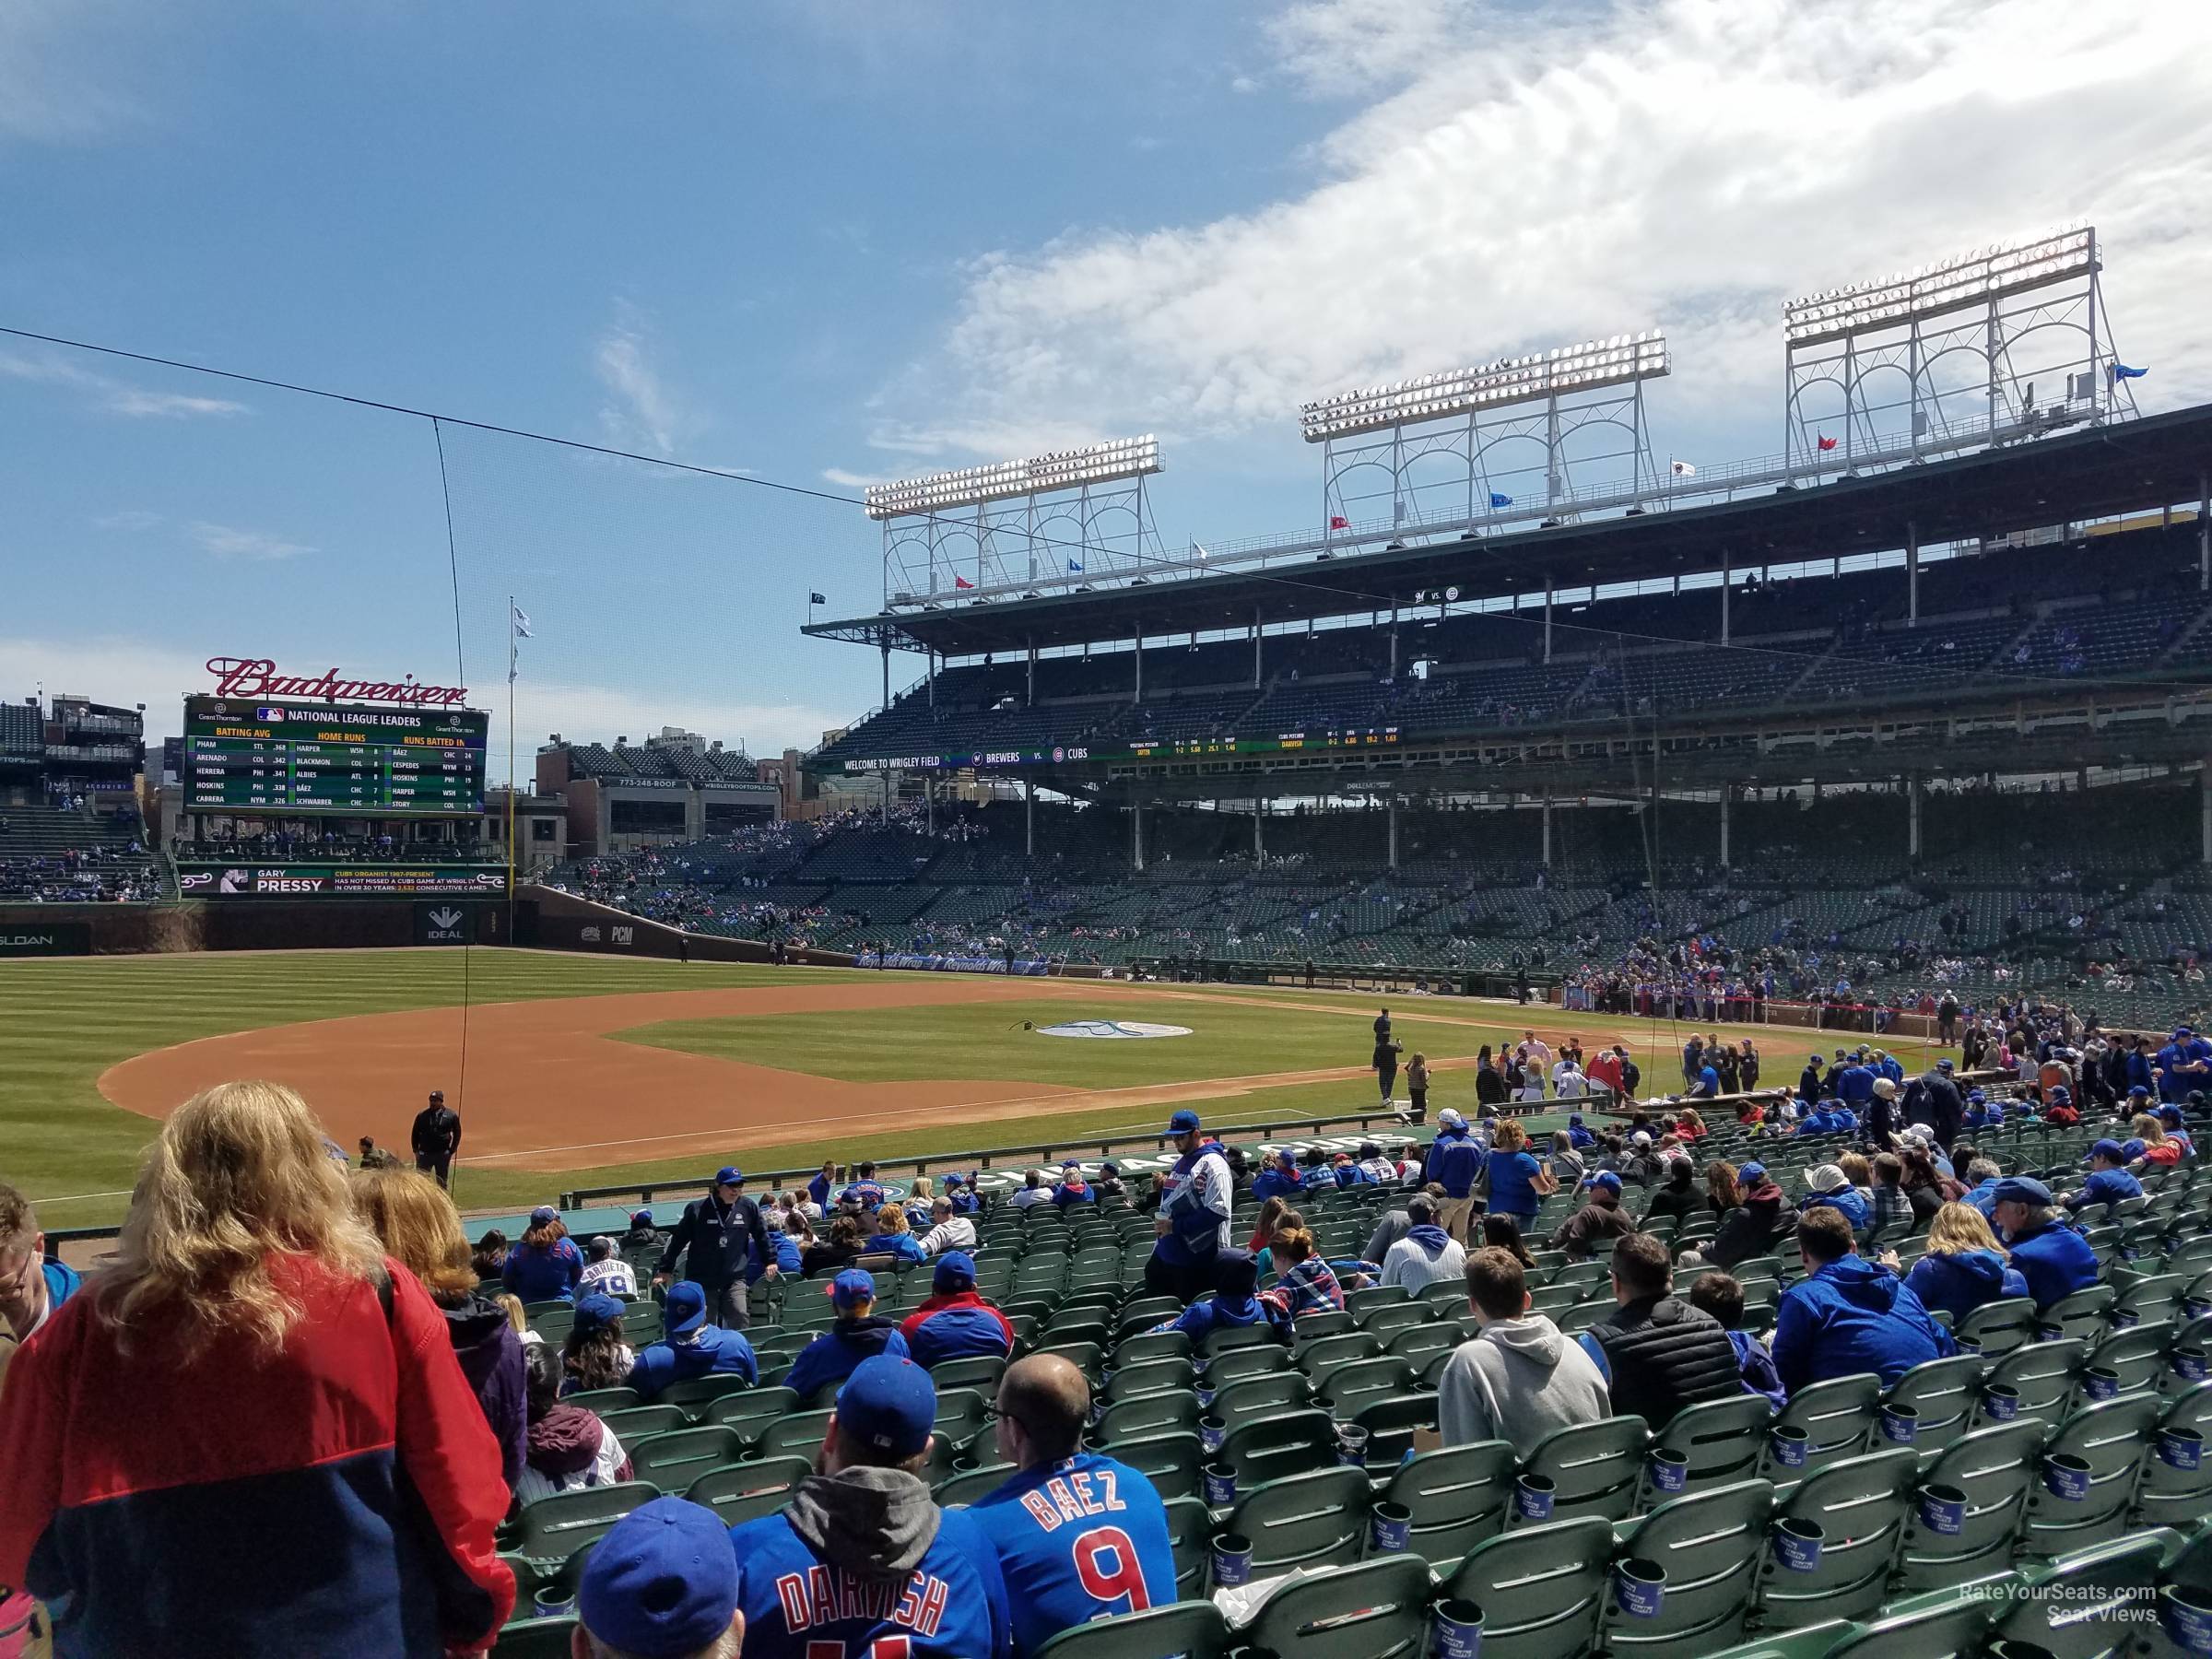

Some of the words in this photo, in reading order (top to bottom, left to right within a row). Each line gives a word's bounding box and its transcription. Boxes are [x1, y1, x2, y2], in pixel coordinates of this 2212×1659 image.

[206, 657, 468, 704] Budweiser
[288, 711, 339, 723] NATIONAL
[343, 713, 378, 724] LEAGUE
[382, 715, 421, 727] LEADERS
[217, 728, 252, 737] BATTING
[318, 733, 343, 741] HOME
[345, 734, 366, 742] RUNS
[404, 736, 425, 745] RUNS
[427, 737, 454, 746] BATTED
[986, 752, 1020, 763] BREWERS
[1068, 748, 1088, 759] CUBS
[845, 759, 877, 770] WELCOME
[878, 759, 888, 769] TO
[889, 758, 920, 768] WRIGLEY
[922, 757, 940, 767] FIELD
[704, 782, 776, 791] WRIGLEYROOFTOPS.COM
[257, 880, 323, 892] PRESSY
[428, 930, 464, 939] IDEAL
[612, 926, 633, 943] PCM
[900, 957, 922, 969] Wrap
[945, 959, 987, 971] Reynolds
[990, 960, 1009, 972] Wra
[1258, 1134, 1418, 1153] CUBS
[587, 1262, 626, 1280] ARRIETA
[1020, 1471, 1127, 1533] BAEZ
[1073, 1525, 1151, 1614] 9
[776, 1564, 948, 1638] DARVISH
